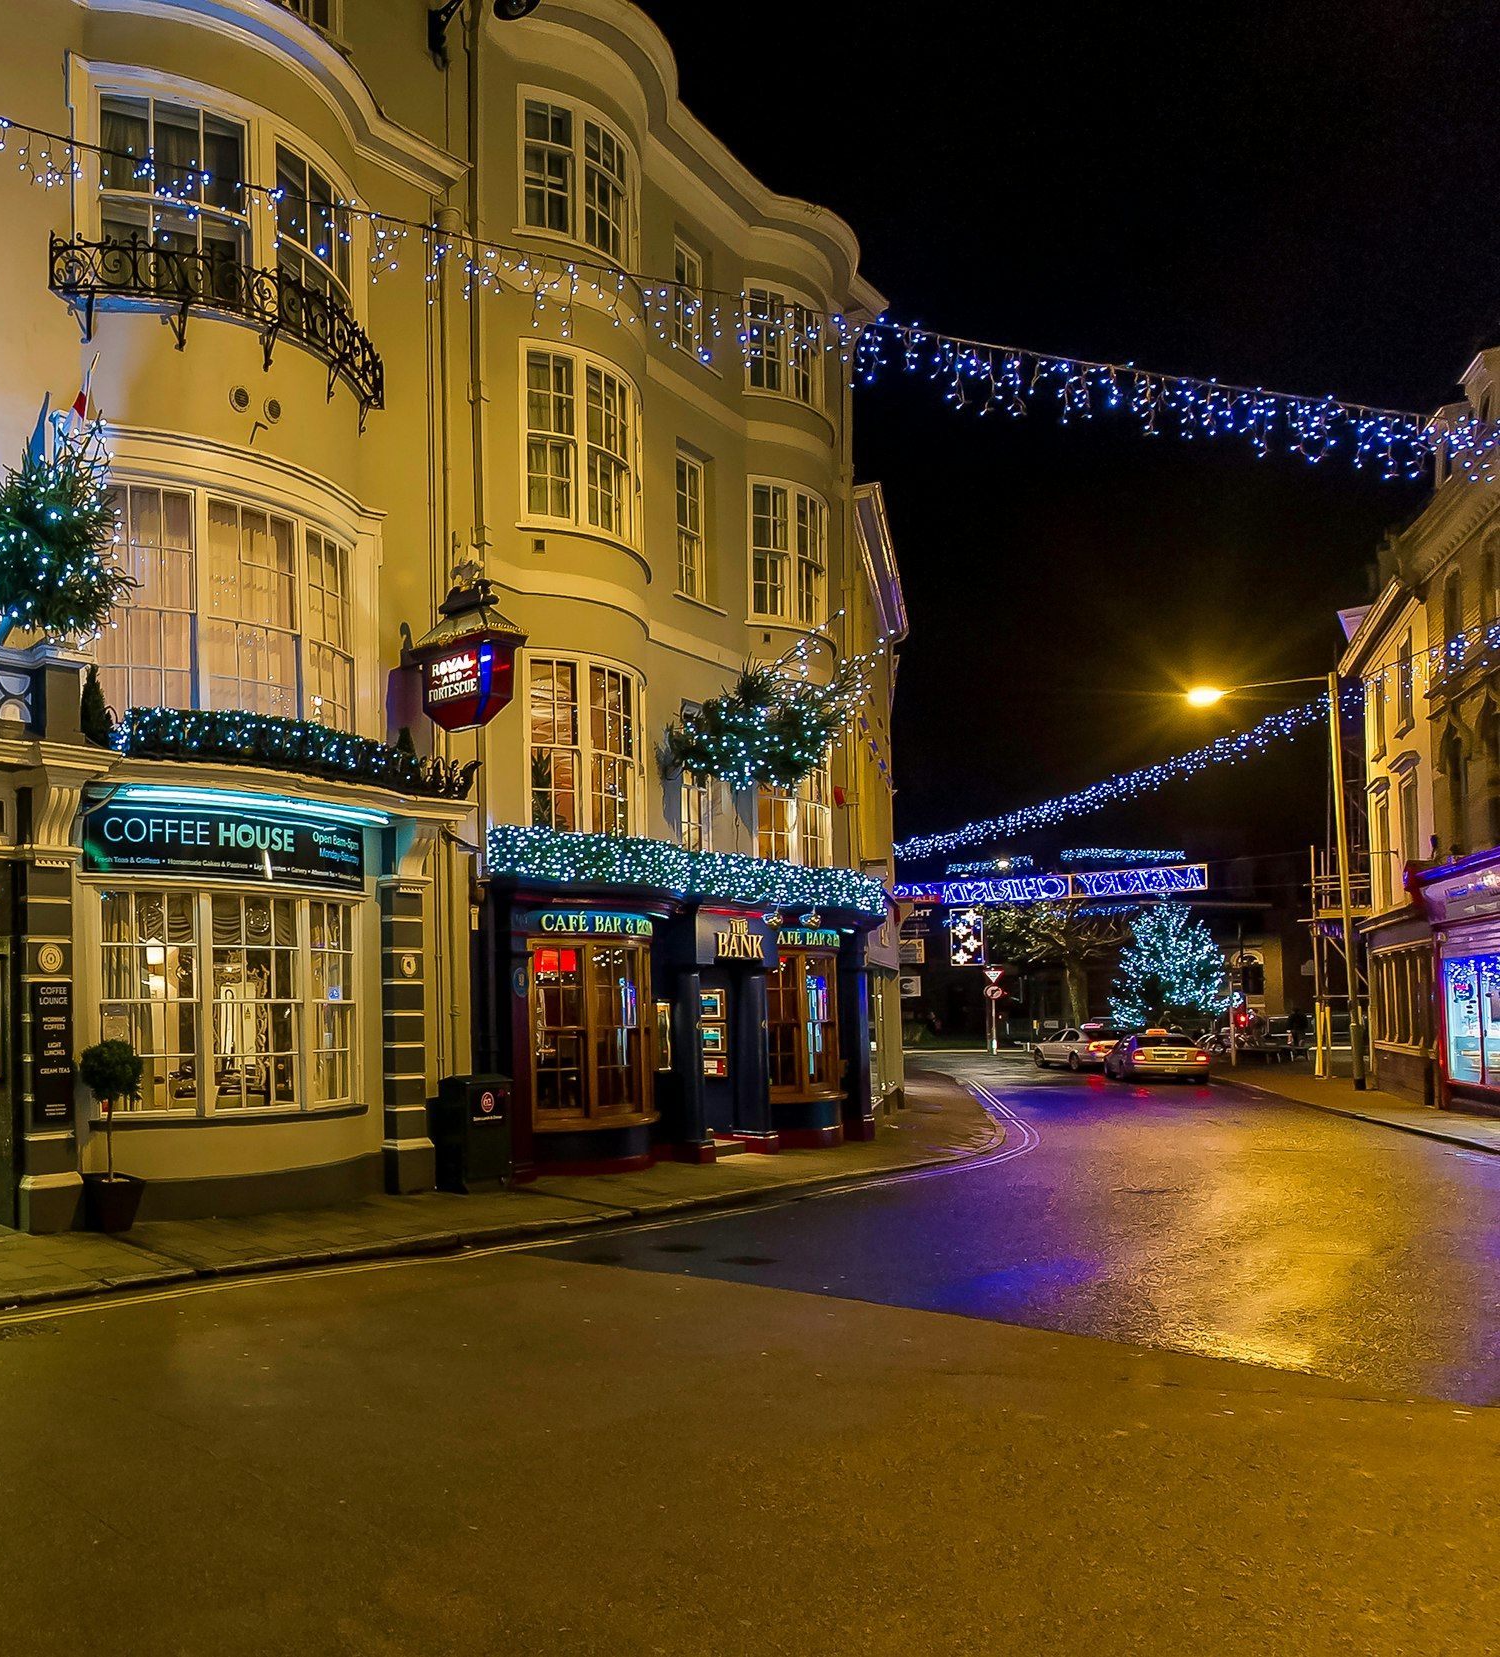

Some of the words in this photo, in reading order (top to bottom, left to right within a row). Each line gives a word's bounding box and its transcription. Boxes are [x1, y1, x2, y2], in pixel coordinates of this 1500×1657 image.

[431, 654, 474, 677] ROYAL
[441, 671, 463, 687] AND
[428, 678, 477, 703] FORTESCUE
[103, 817, 210, 846] COFFEE
[218, 822, 295, 852] HOUSE
[312, 831, 332, 845] Open
[291, 867, 307, 875] Carvery
[541, 911, 589, 932] CAFÉ
[594, 915, 622, 933] BAR
[626, 918, 634, 934] &
[730, 918, 749, 935] THE
[717, 932, 765, 959] BANK
[806, 931, 825, 946] BAR
[40, 986, 67, 995] COFFEE
[39, 997, 68, 1005] LOUNGE
